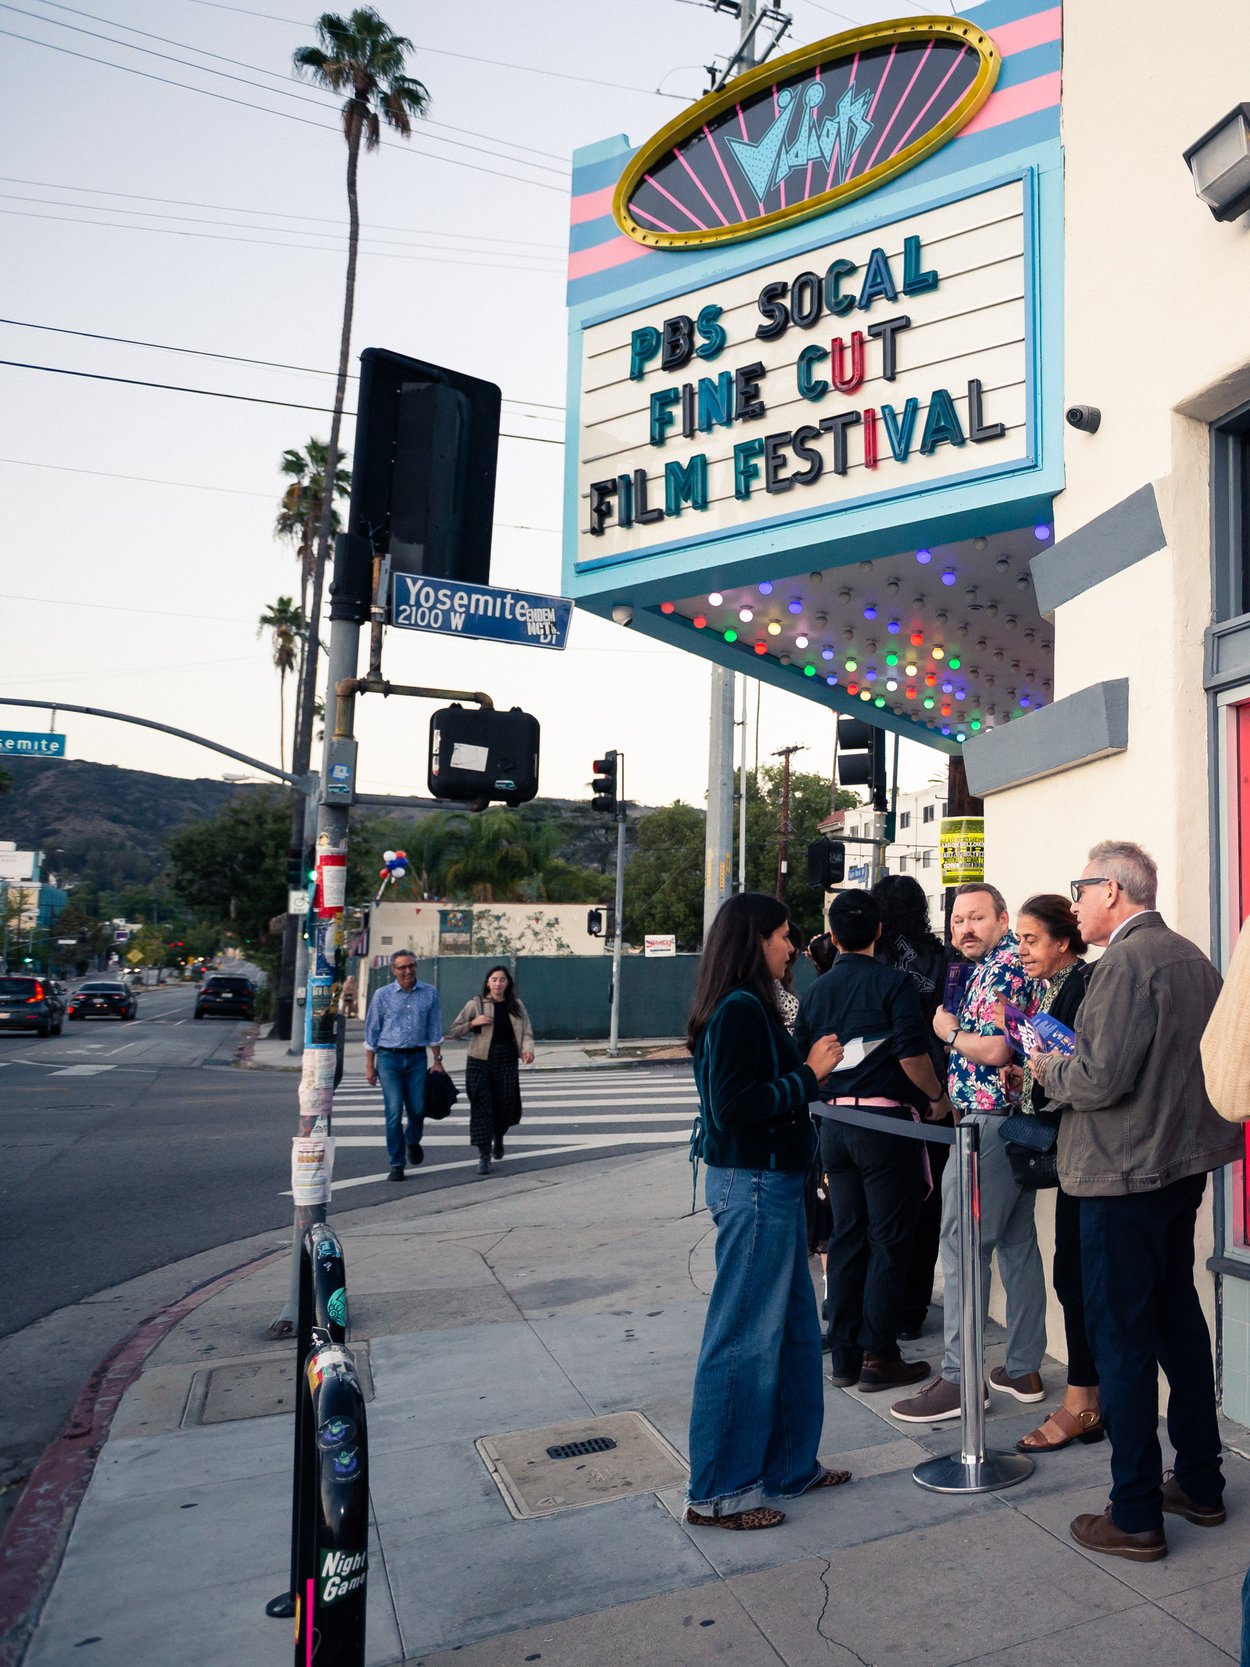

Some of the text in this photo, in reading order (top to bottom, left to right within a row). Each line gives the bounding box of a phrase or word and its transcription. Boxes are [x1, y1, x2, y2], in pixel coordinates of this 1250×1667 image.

[724, 80, 874, 204] Vidiots
[630, 235, 939, 381] PBS SOCAL
[650, 315, 911, 447] FINE CUT
[588, 378, 1005, 536] FILM FESTIVAL
[398, 605, 465, 631] 2100 W
[405, 577, 529, 621] Yosemite
[321, 1551, 366, 1578] Night
